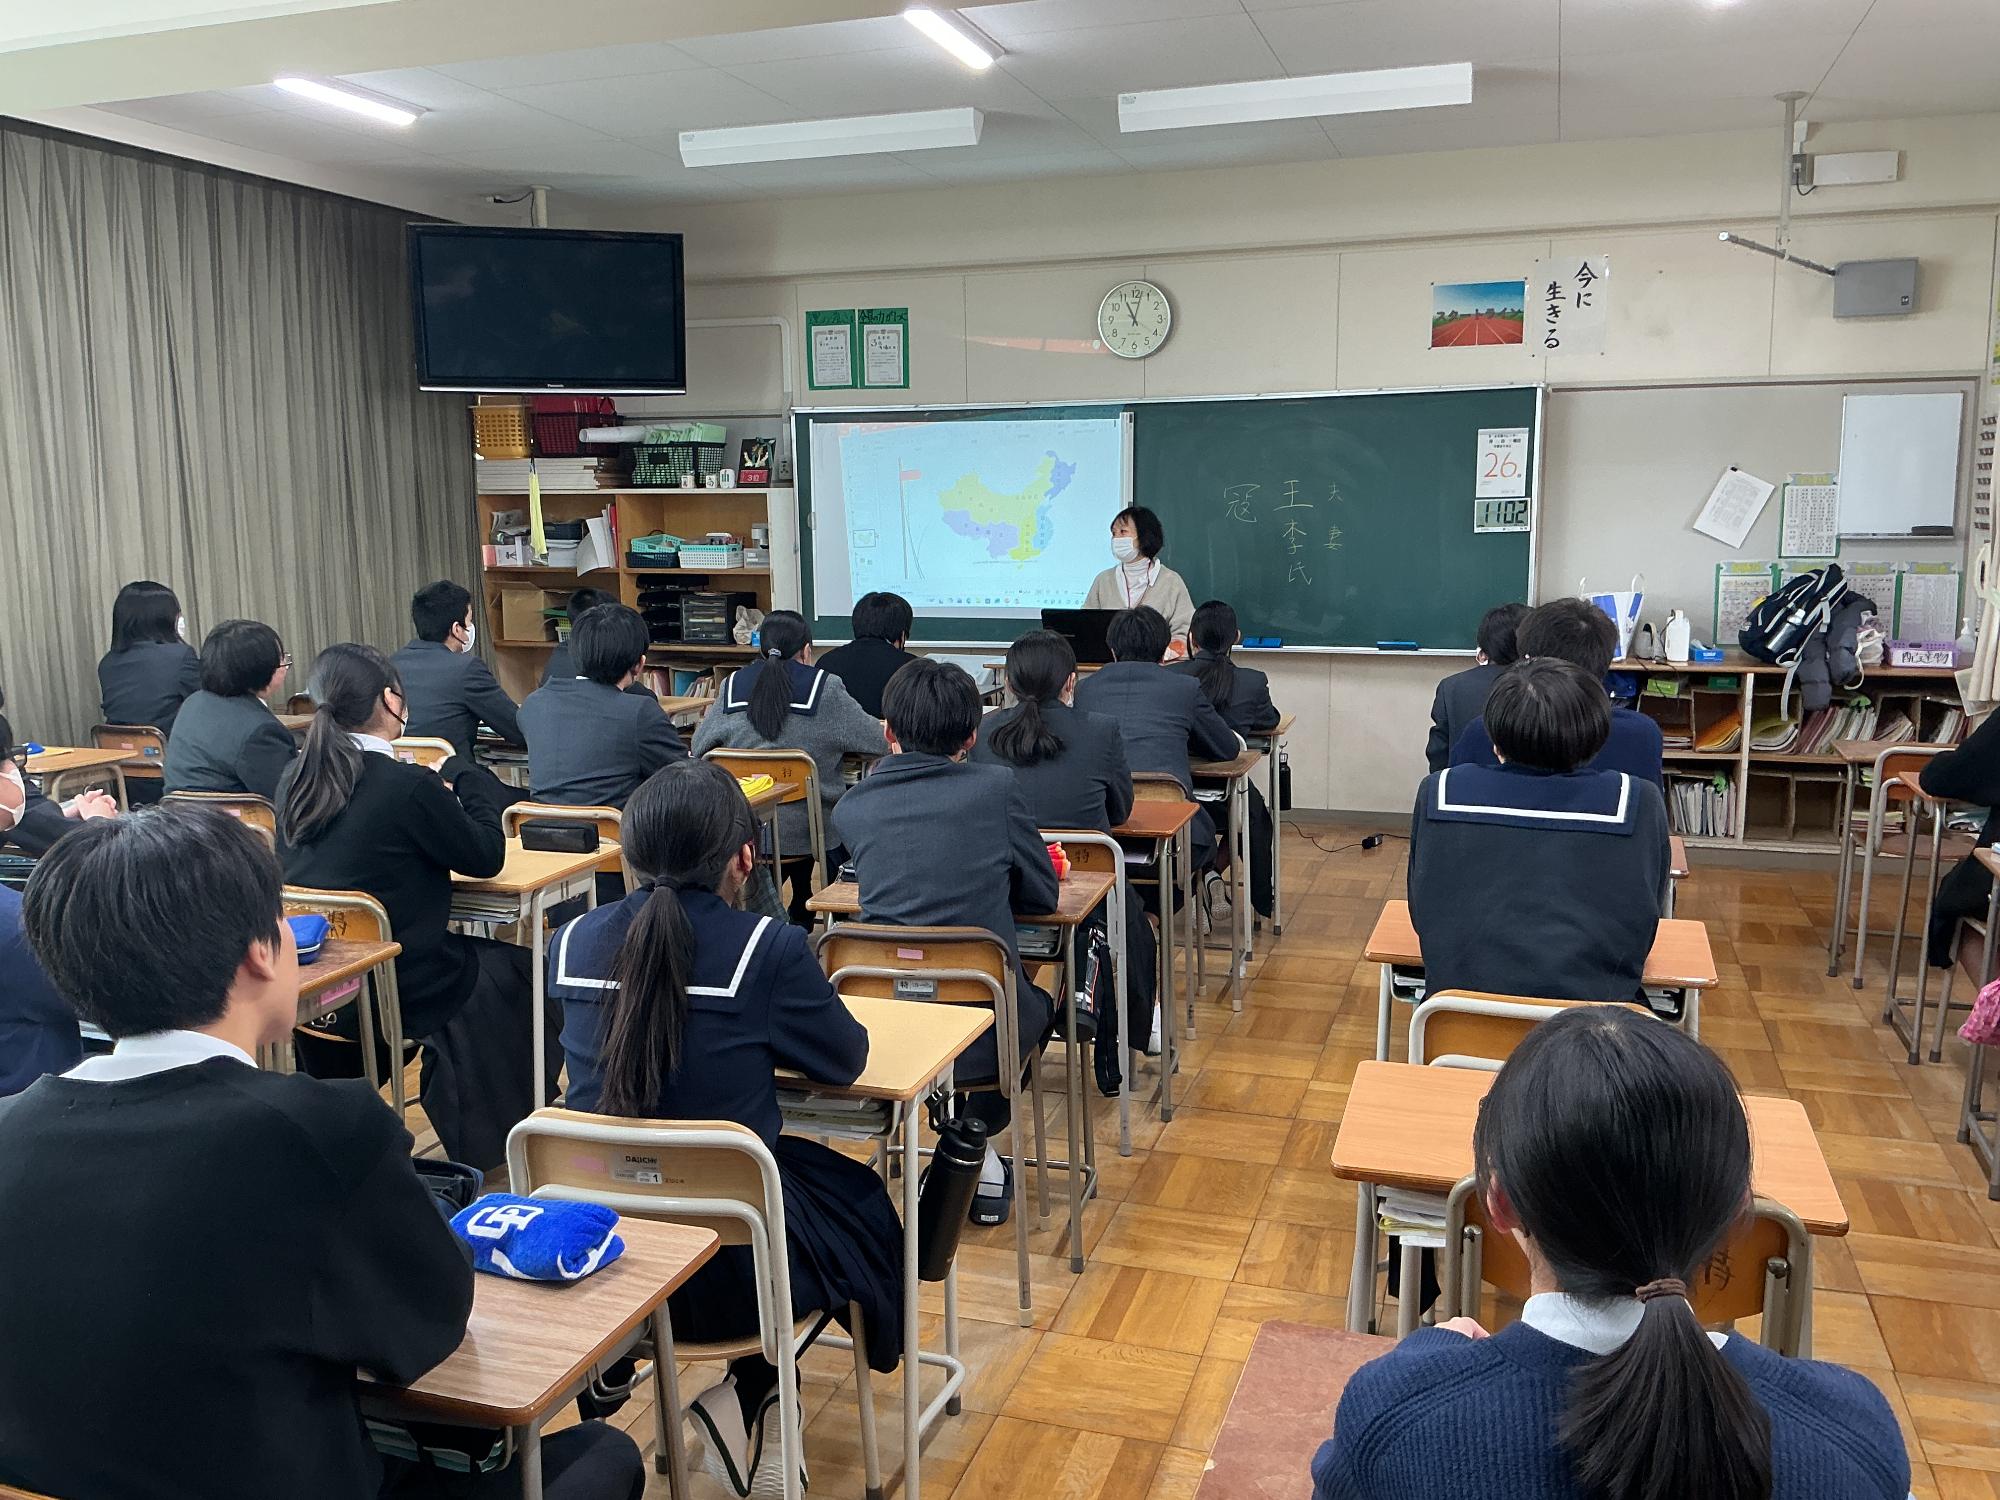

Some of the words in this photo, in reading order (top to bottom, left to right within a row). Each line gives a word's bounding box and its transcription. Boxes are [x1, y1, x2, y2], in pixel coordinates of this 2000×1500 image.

[1573, 261, 1599, 309] 今に
[1120, 294, 1126, 302] 11
[1131, 290, 1140, 298] 12
[1112, 303, 1120, 311] 10
[1154, 302, 1160, 310] 2
[1543, 281, 1567, 349] 生きる
[1109, 316, 1114, 324] 9
[1157, 315, 1163, 324] 3
[1112, 329, 1118, 337] 8
[1121, 338, 1126, 346] 7
[1132, 341, 1138, 349] 6
[1144, 337, 1150, 345] 5
[1484, 452, 1518, 478] 26
[747, 474, 760, 482] 3位
[652, 1173, 659, 1183] 1
